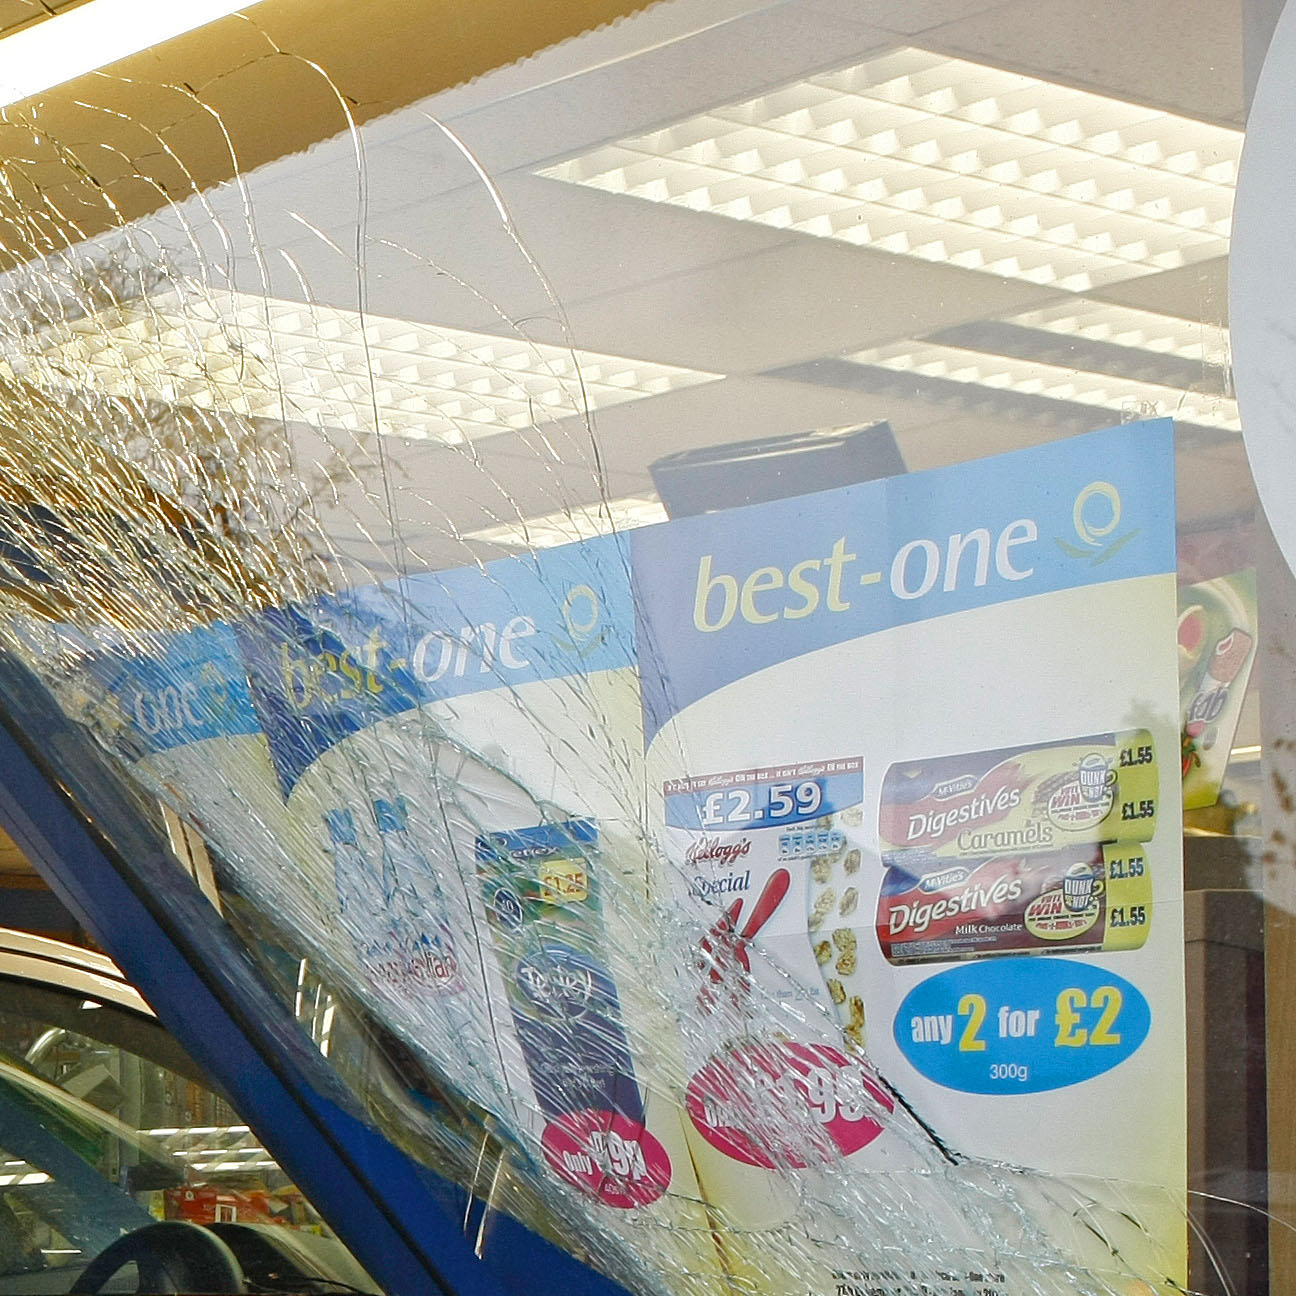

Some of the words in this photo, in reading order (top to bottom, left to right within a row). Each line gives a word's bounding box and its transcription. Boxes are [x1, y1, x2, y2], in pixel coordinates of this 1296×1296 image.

[692, 517, 1038, 633] best-one
[1119, 746, 1153, 767] £1.55
[702, 780, 822, 825] £2.59
[908, 786, 1021, 841] Digestives
[1121, 799, 1155, 821] £1.55
[957, 824, 1053, 850] Caramels
[1109, 857, 1144, 879] £1.55
[1064, 878, 1092, 895] DUNK
[888, 875, 1022, 936] Digestives
[1110, 906, 1146, 929] £1.55
[955, 922, 978, 935] Milk
[978, 922, 1023, 934] Chocolate
[911, 1014, 954, 1045] any
[958, 994, 987, 1051] 2
[997, 1006, 1040, 1038] for
[1054, 986, 1123, 1048] £2
[989, 1064, 1028, 1081] 300g
[563, 1150, 593, 1175] Only
